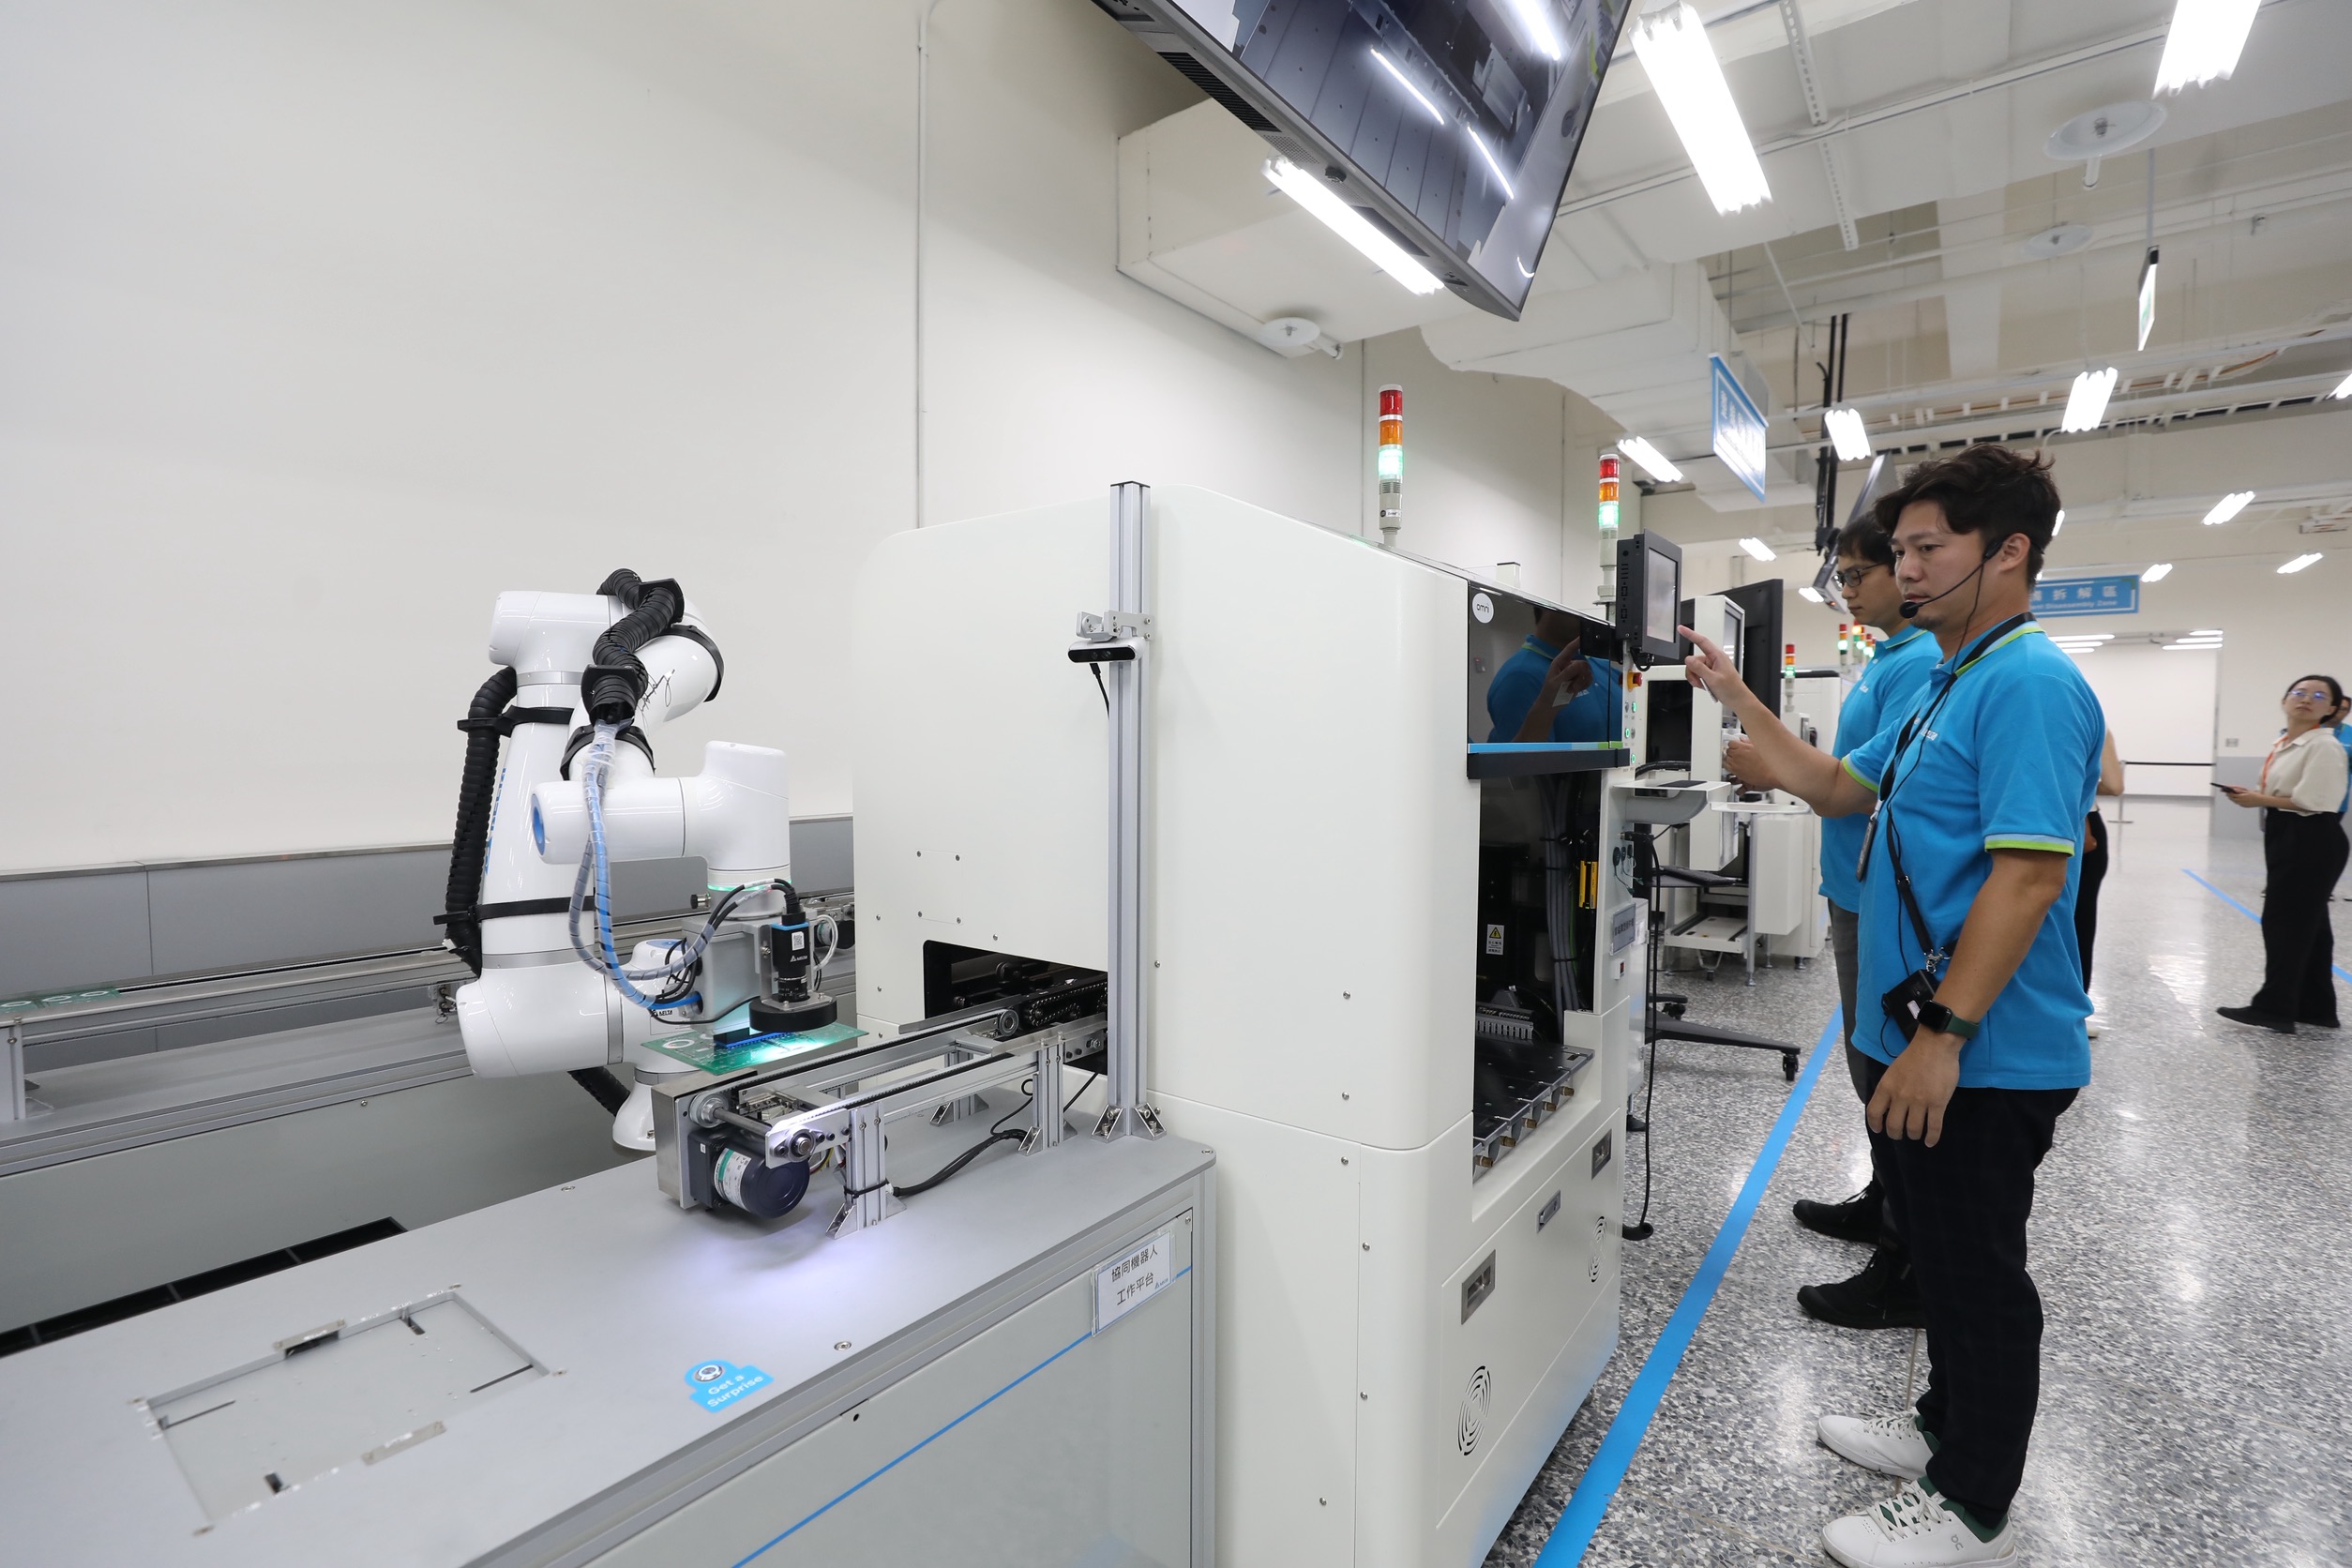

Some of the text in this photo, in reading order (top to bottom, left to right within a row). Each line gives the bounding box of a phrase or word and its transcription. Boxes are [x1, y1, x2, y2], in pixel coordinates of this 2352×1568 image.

[1111, 1244, 1158, 1282] 協同機器人
[1117, 1273, 1154, 1305] 工作平台
[707, 1376, 763, 1407] Surprise
[708, 1380, 734, 1395] Get
